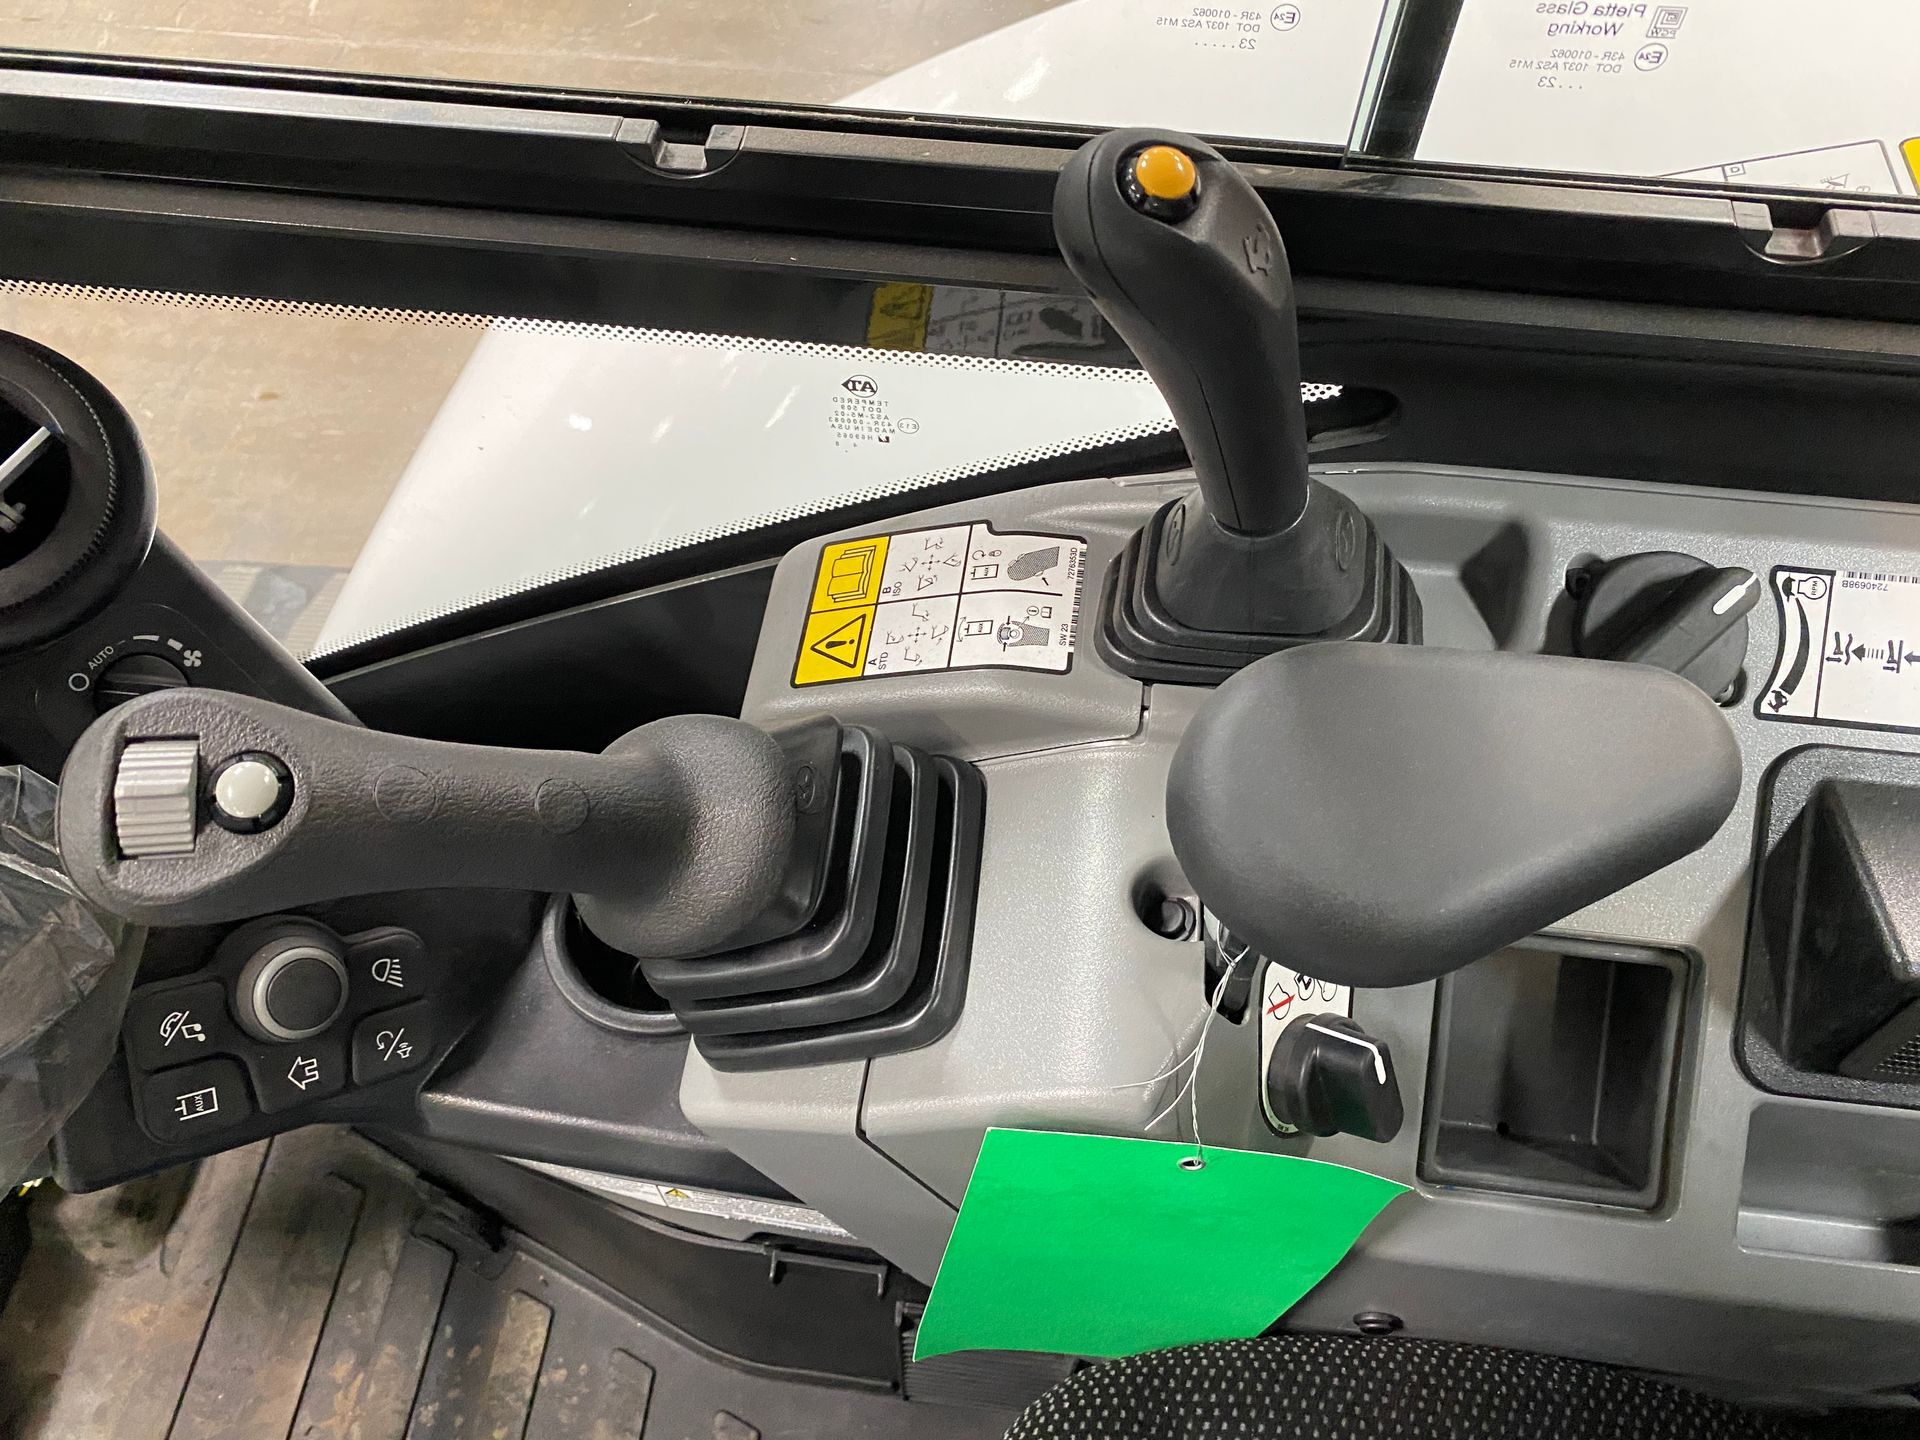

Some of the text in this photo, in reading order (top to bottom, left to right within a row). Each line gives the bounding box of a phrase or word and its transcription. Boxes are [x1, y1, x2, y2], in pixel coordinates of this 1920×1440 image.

[1067, 547, 1078, 580] 7276353D
[892, 581, 902, 596] ISO
[1842, 580, 1889, 592] 7240698B
[1059, 624, 1069, 646] SW 23
[88, 646, 114, 670] AUTO
[878, 652, 888, 670] STD
[194, 1094, 204, 1111] AUX
